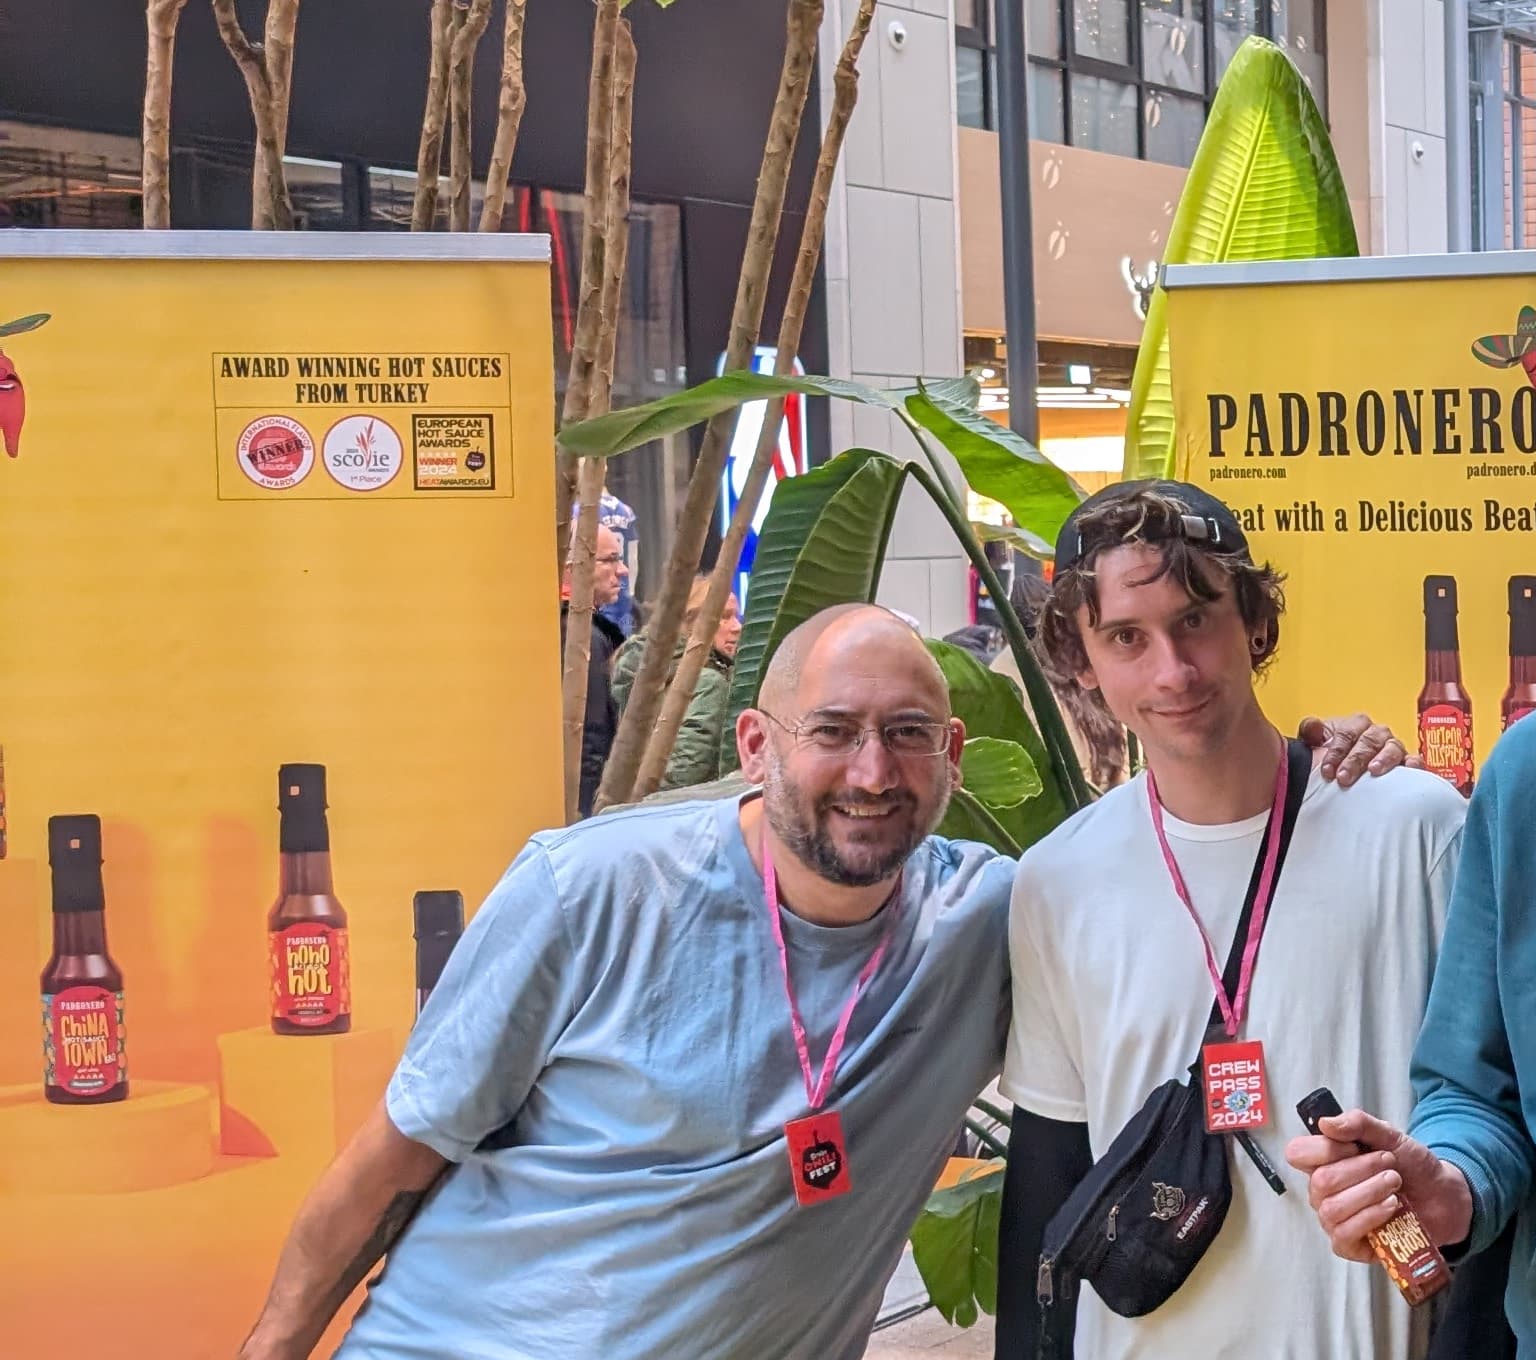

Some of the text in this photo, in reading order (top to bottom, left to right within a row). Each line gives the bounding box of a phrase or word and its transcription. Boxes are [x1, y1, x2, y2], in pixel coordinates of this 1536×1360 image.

[221, 357, 502, 378] AWARD WINNING HOT SAUCES
[296, 383, 430, 403] FROM TURKEY
[418, 420, 482, 428] EUROPEAN
[418, 429, 485, 438] HOT SAUCE
[247, 439, 305, 465] WINNER
[419, 439, 471, 448] AWARDS
[419, 457, 457, 465] WINNER
[1210, 465, 1287, 481] padronero.com
[260, 477, 296, 487] AWARDS
[1225, 501, 1264, 531] eat
[1275, 501, 1324, 531] with
[1335, 508, 1348, 531] a
[1359, 500, 1473, 531] Delicious
[62, 1040, 108, 1067] TOWN
[1208, 1060, 1260, 1077] CREW
[1209, 1076, 1261, 1093] PASS
[1212, 1110, 1263, 1127] 2024
[809, 1161, 836, 1180] FEST
[1177, 1196, 1210, 1240] EASTPAK
